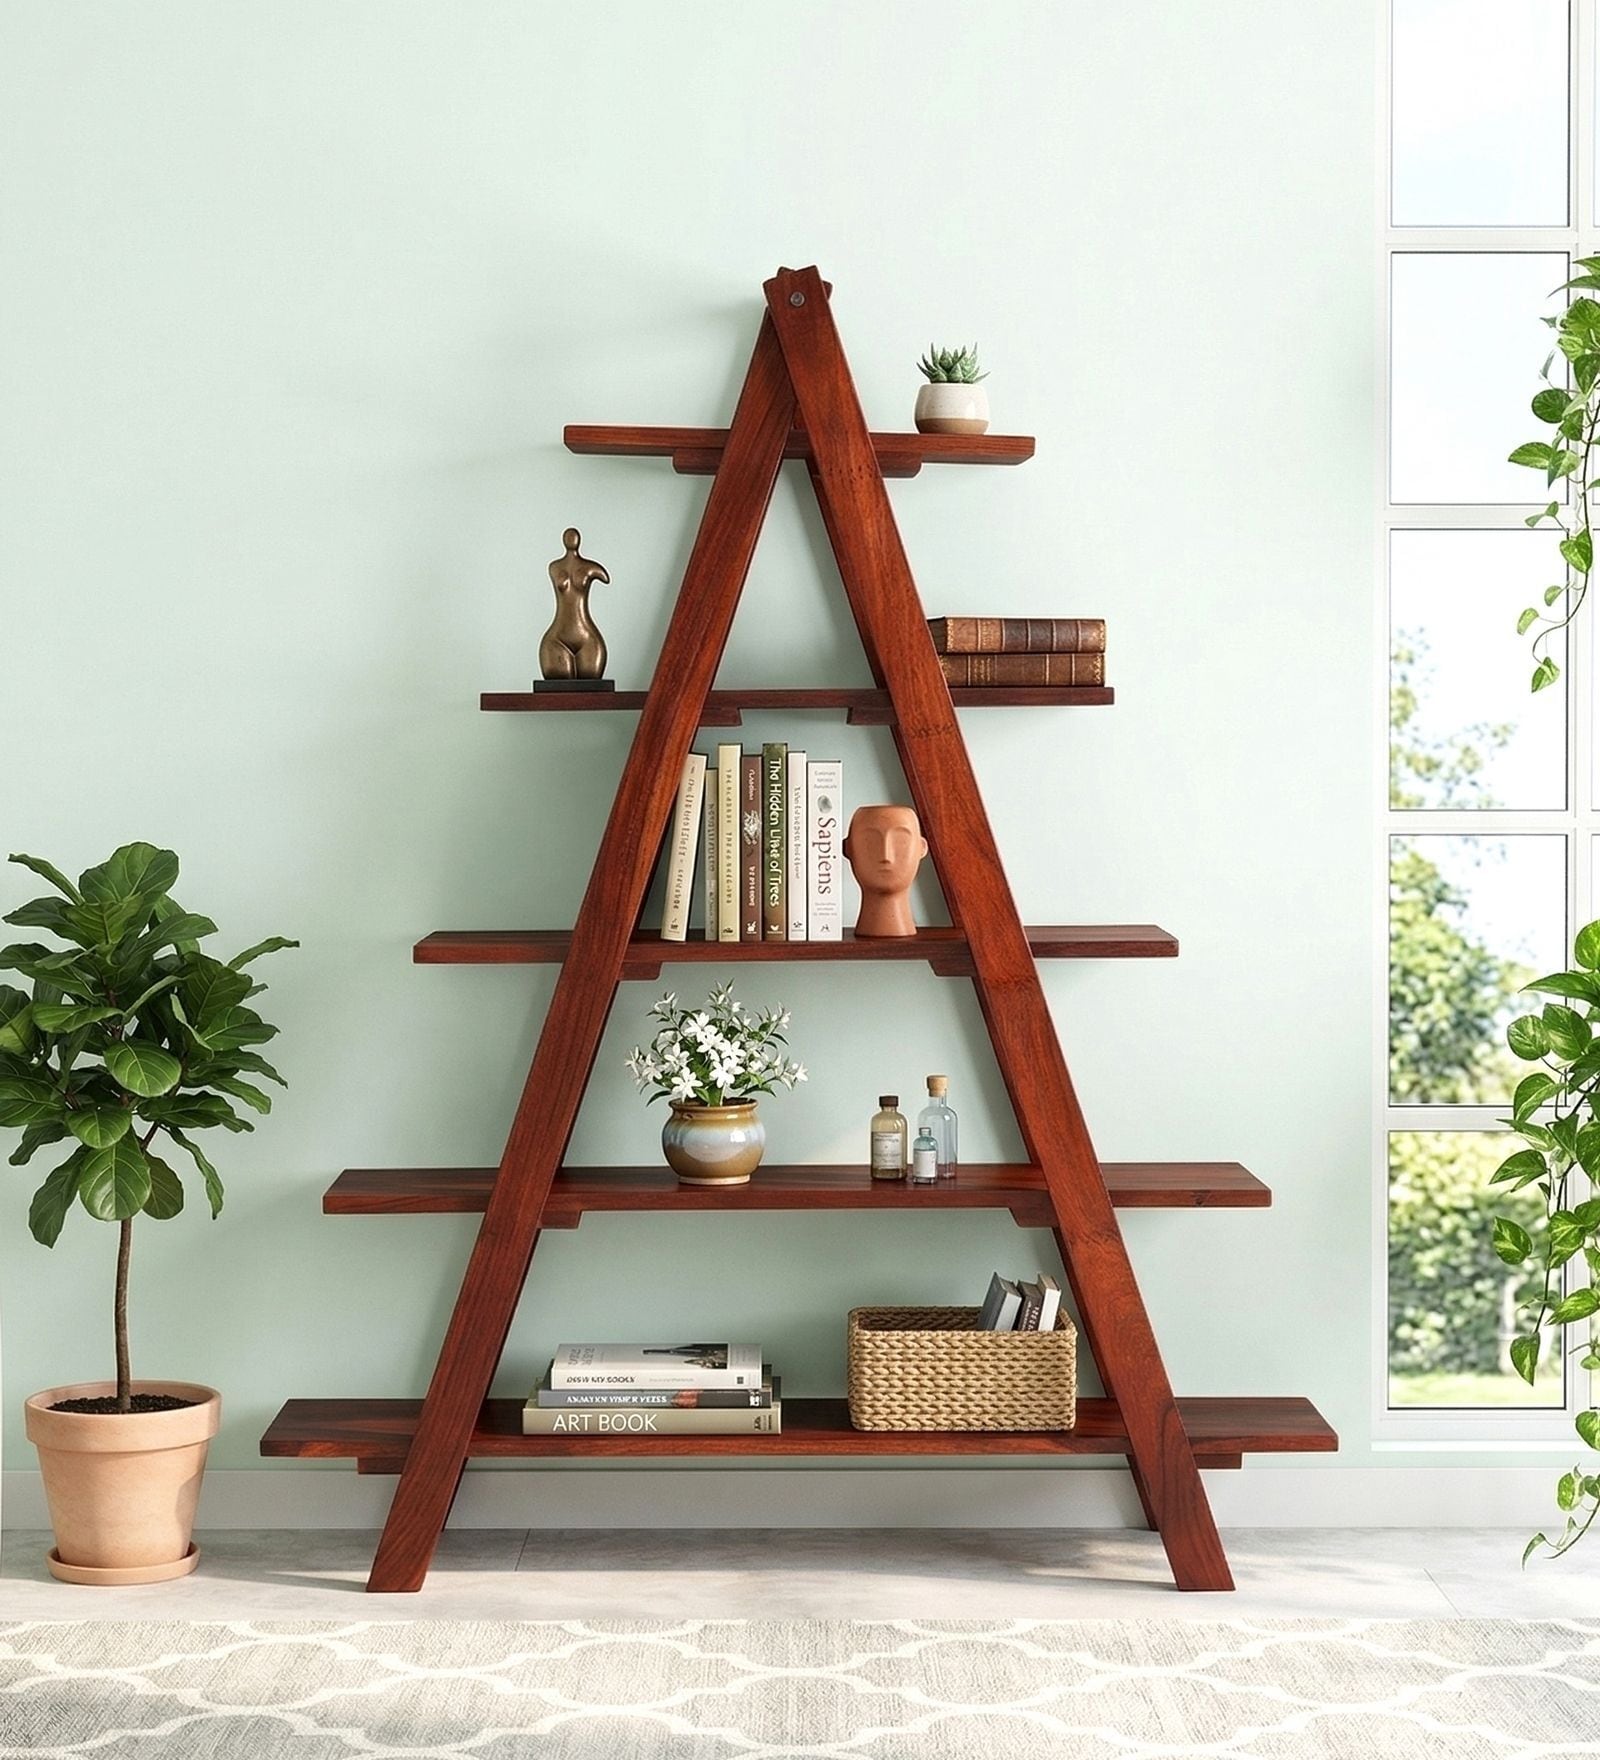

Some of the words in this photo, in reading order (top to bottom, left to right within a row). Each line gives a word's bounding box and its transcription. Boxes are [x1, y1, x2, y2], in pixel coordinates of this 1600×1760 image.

[769, 860, 782, 874] of
[811, 816, 837, 895] Sapiens
[769, 875, 782, 907] Trees
[552, 1413, 593, 1432] ART
[598, 1413, 658, 1432] BOOK
